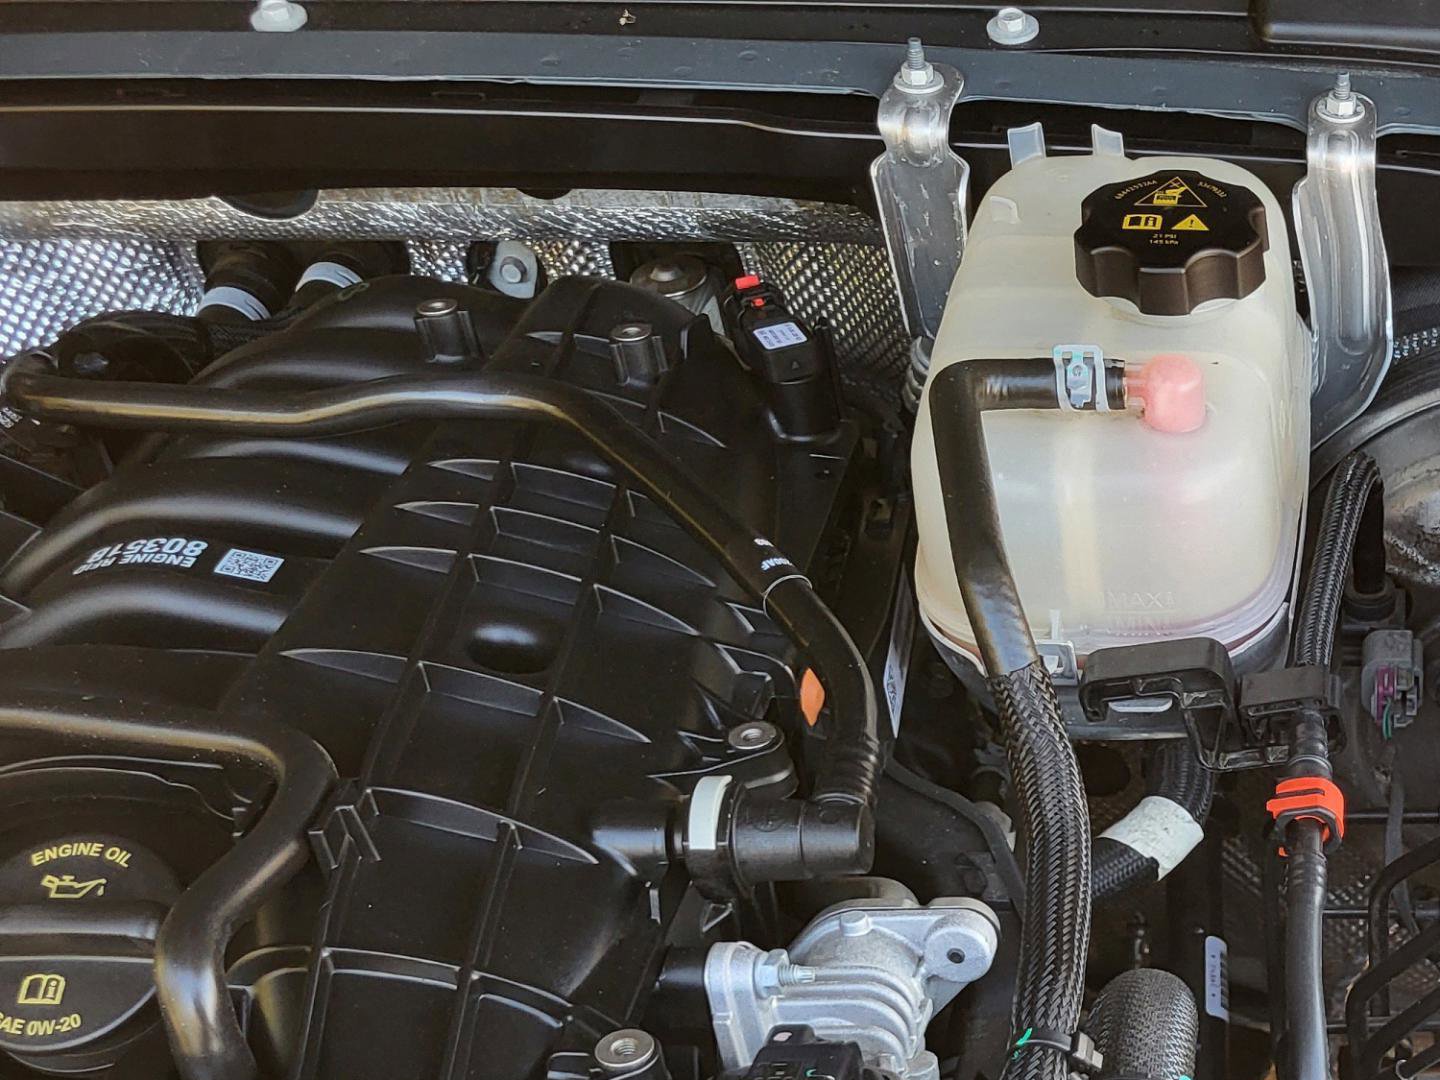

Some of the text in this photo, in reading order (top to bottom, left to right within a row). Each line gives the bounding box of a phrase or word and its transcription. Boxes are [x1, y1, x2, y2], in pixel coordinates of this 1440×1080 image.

[72, 553, 196, 576] ENGINE RFID
[31, 842, 132, 868] ENGINE OIL
[27, 1013, 82, 1036] 0W-20
